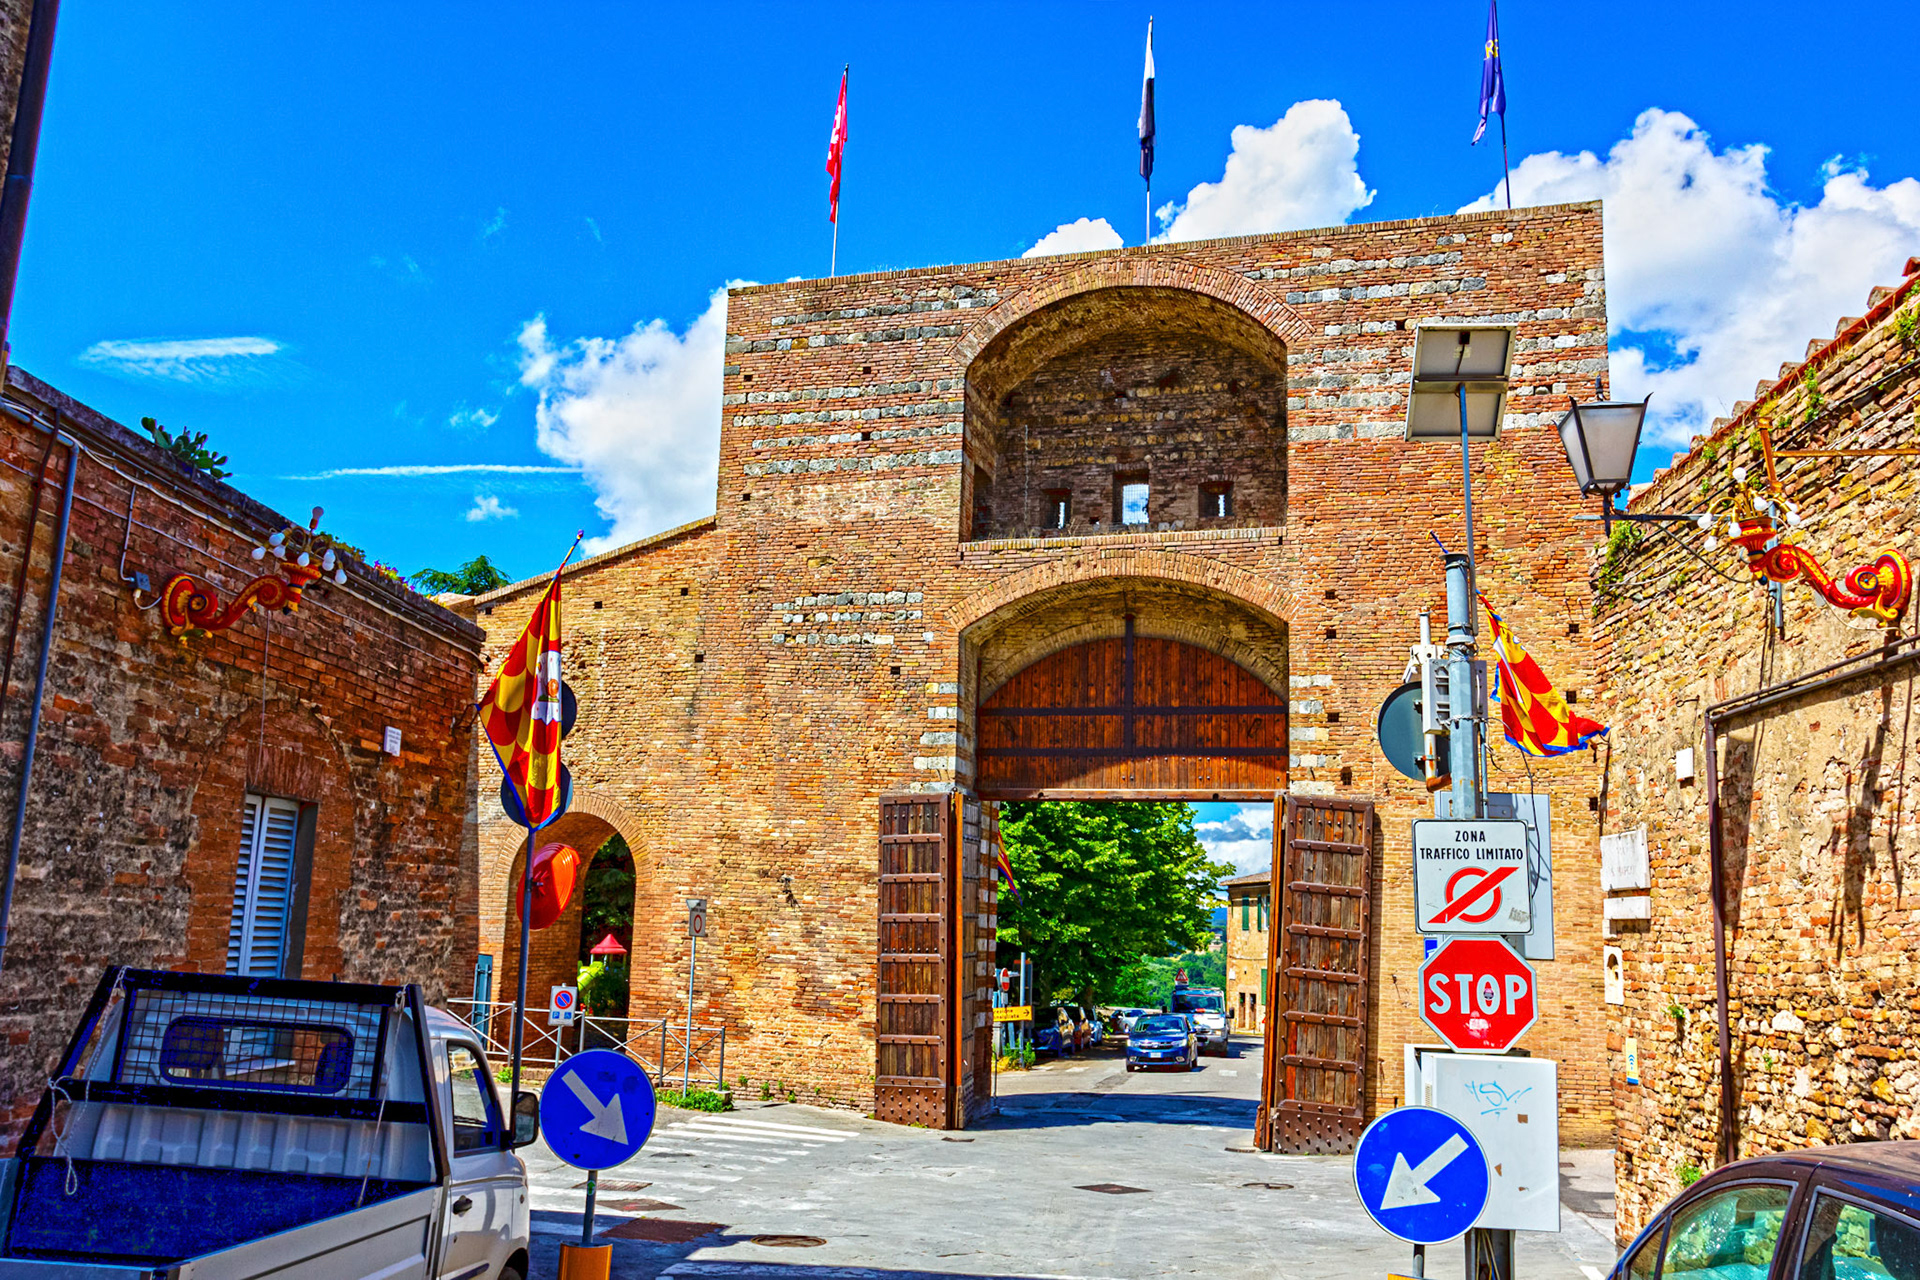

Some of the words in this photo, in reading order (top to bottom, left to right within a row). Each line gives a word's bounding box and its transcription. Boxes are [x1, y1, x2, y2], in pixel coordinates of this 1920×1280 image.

[1455, 830, 1486, 842] ZONA
[1419, 847, 1470, 860] TRAFFICO
[1476, 847, 1524, 860] LIMITATO
[1428, 972, 1528, 1016] STOP
